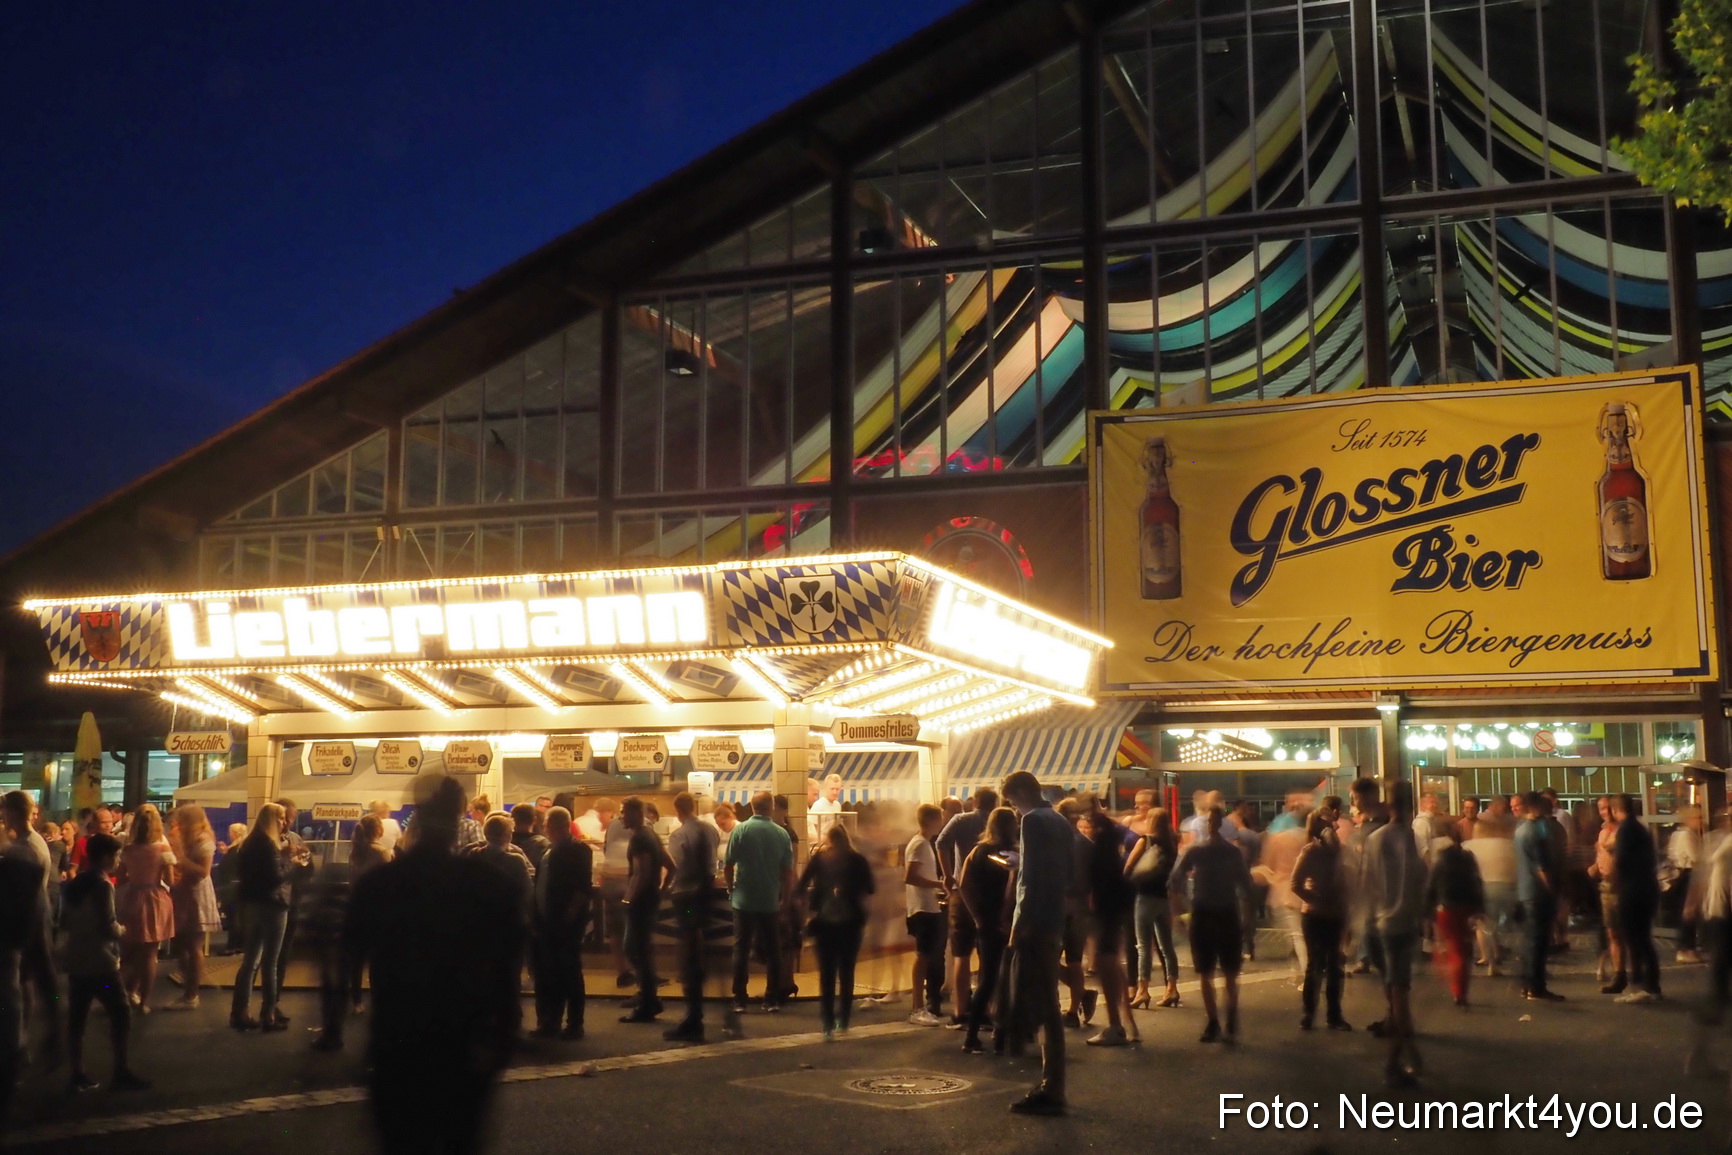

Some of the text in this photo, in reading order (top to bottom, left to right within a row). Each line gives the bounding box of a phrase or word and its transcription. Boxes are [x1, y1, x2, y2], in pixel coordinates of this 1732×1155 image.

[1331, 418, 1428, 452] Seit 1574
[1230, 432, 1542, 608] Glossner
[1390, 524, 1543, 595] Bier
[168, 591, 708, 660] Liebermann
[1144, 620, 1224, 663] Der
[1233, 617, 1406, 674] hochfeine
[1419, 609, 1654, 668] Biergenuss
[171, 735, 226, 751] Schaschlik
[839, 719, 914, 740] Pommesfrites
[382, 742, 400, 755] Steak
[549, 740, 585, 752] Currywurst
[623, 740, 659, 752] Bockwurst
